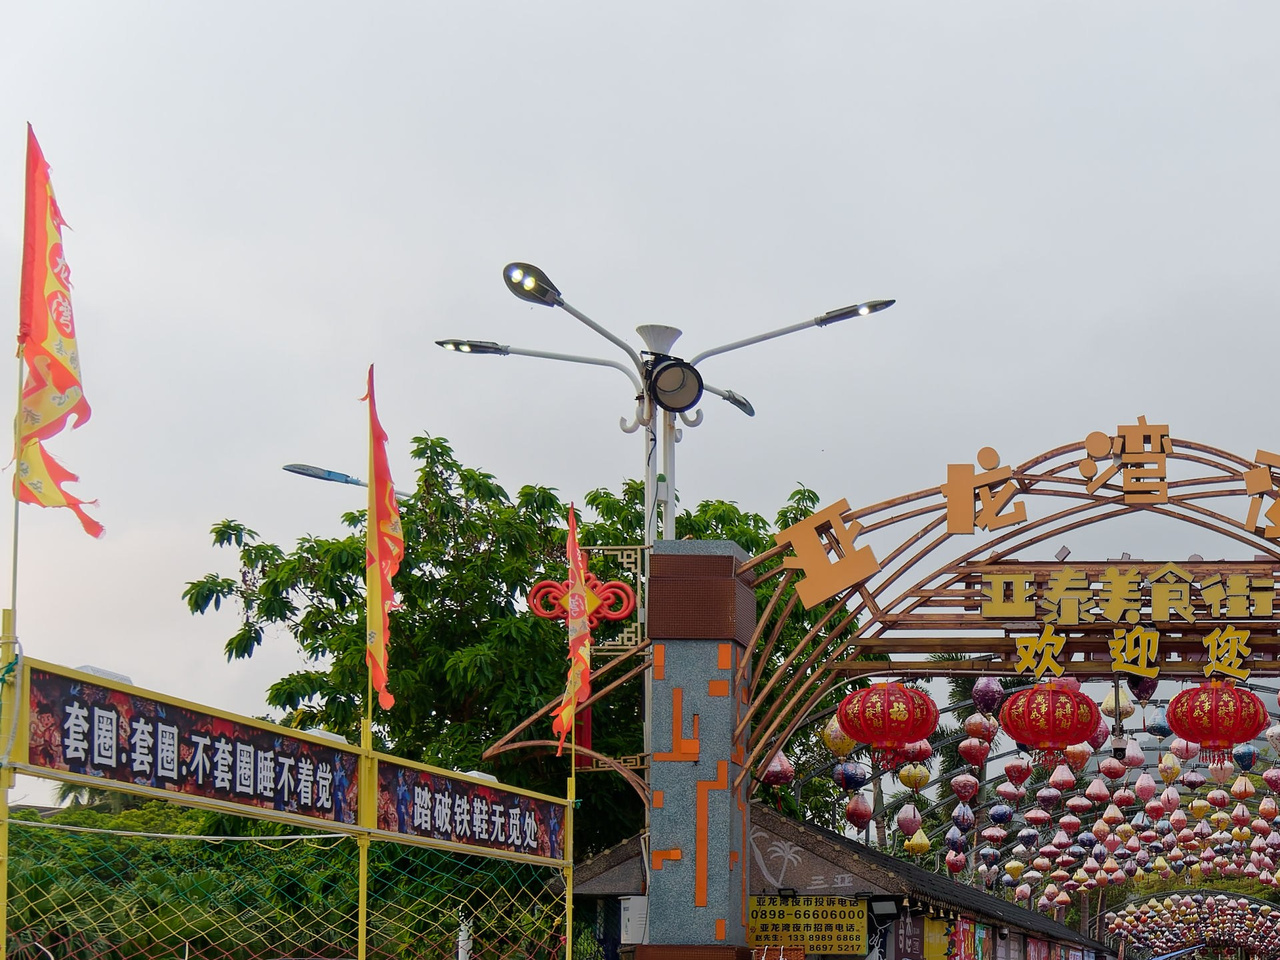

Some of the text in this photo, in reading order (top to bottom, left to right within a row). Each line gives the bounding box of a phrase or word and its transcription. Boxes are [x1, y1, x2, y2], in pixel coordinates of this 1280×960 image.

[981, 563, 1275, 626] 亚泰美食街
[1015, 624, 1253, 679] 欢迎您
[413, 785, 539, 849] 踏破铁鞋无觅处
[806, 874, 854, 889] 三亚
[756, 896, 859, 907] 亚龙湾夜市投诉电话
[751, 909, 865, 920] 0898-66606000
[760, 923, 855, 933] 亚龙湾夜市招商电话
[788, 934, 805, 942] 133
[808, 934, 833, 942] 8989
[836, 934, 861, 942] 6868
[809, 944, 834, 952] 8697
[837, 944, 861, 952] 5217
